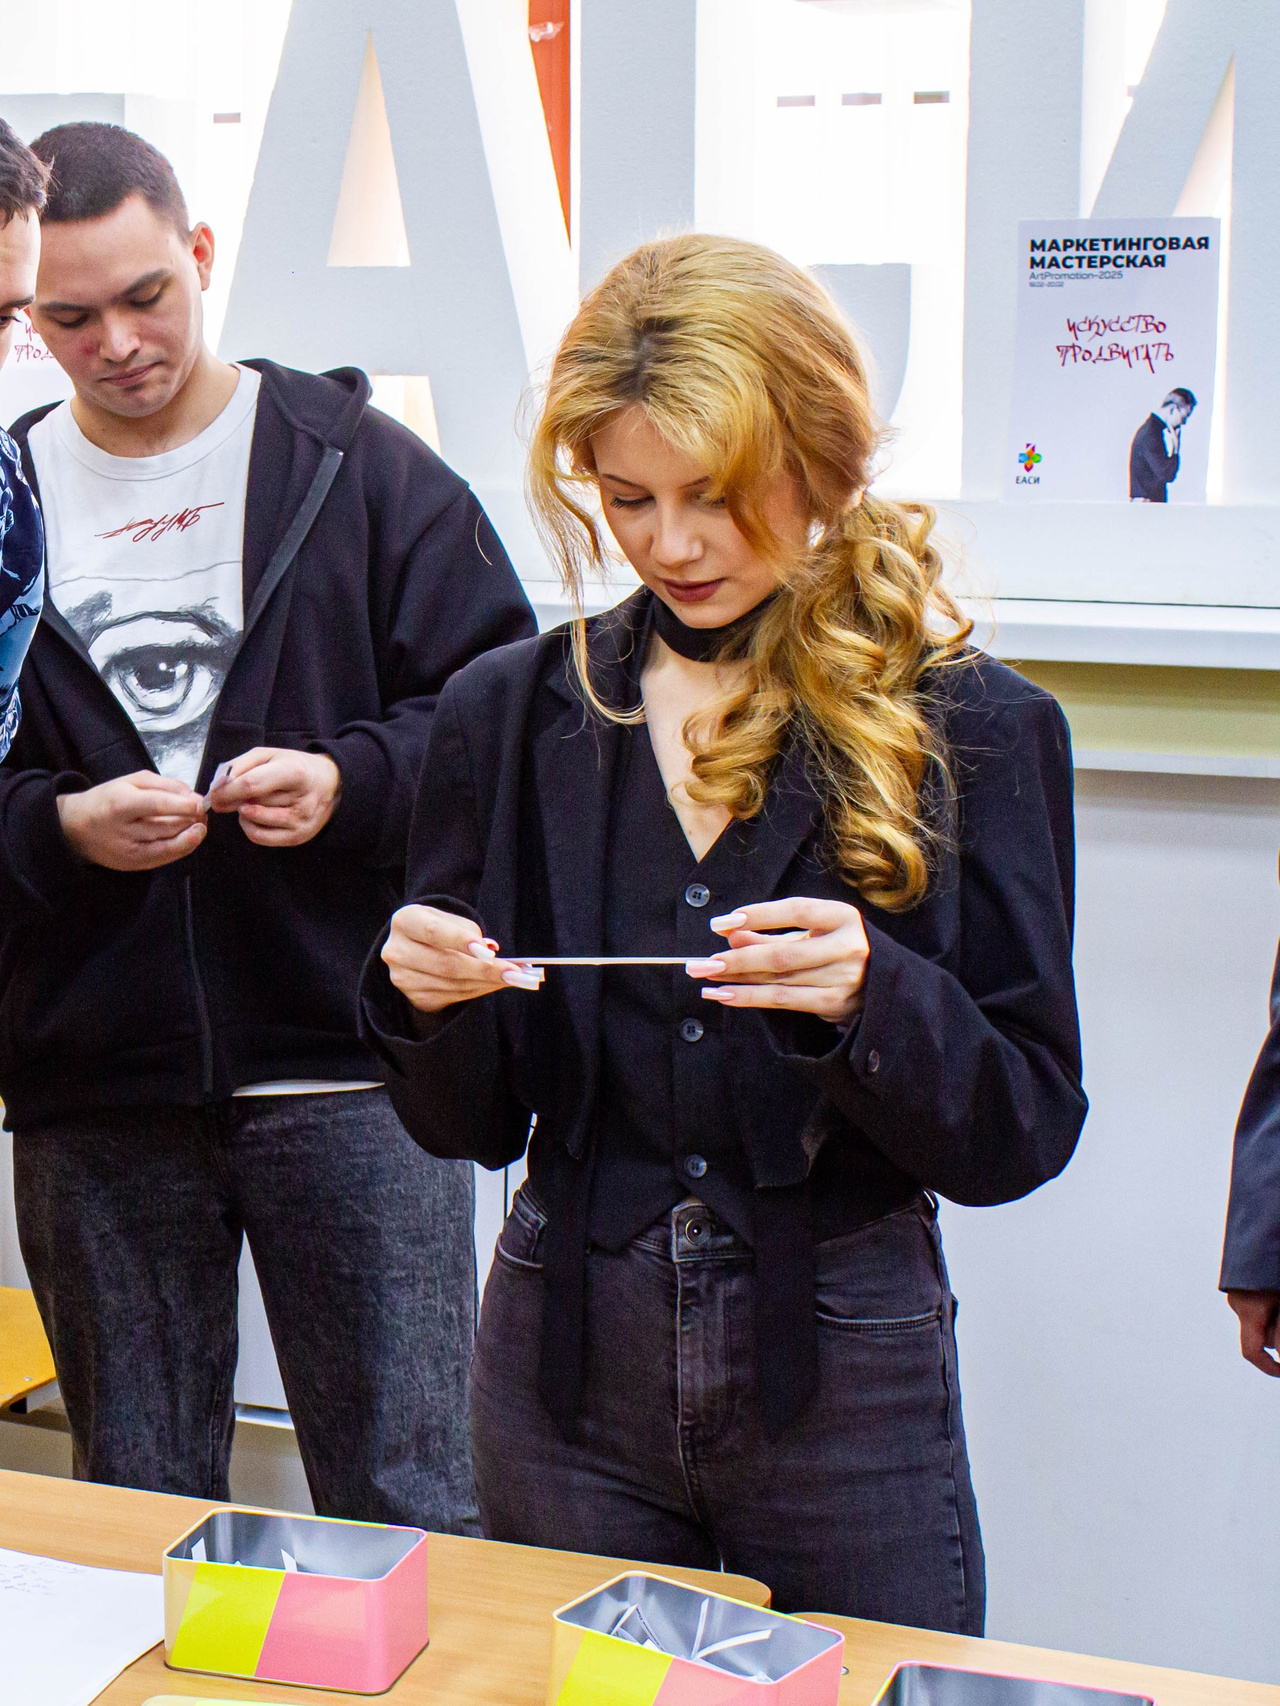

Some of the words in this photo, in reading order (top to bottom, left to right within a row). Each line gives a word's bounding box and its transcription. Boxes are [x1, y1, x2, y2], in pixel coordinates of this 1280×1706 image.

[1030, 236, 1210, 252] МАРКЕТИНГОВАЯ
[1029, 254, 1167, 269] МАСТЕРСКАЯ
[1029, 270, 1124, 281] ArtPromotion-2025
[1015, 475, 1041, 485] ЕАСИ
